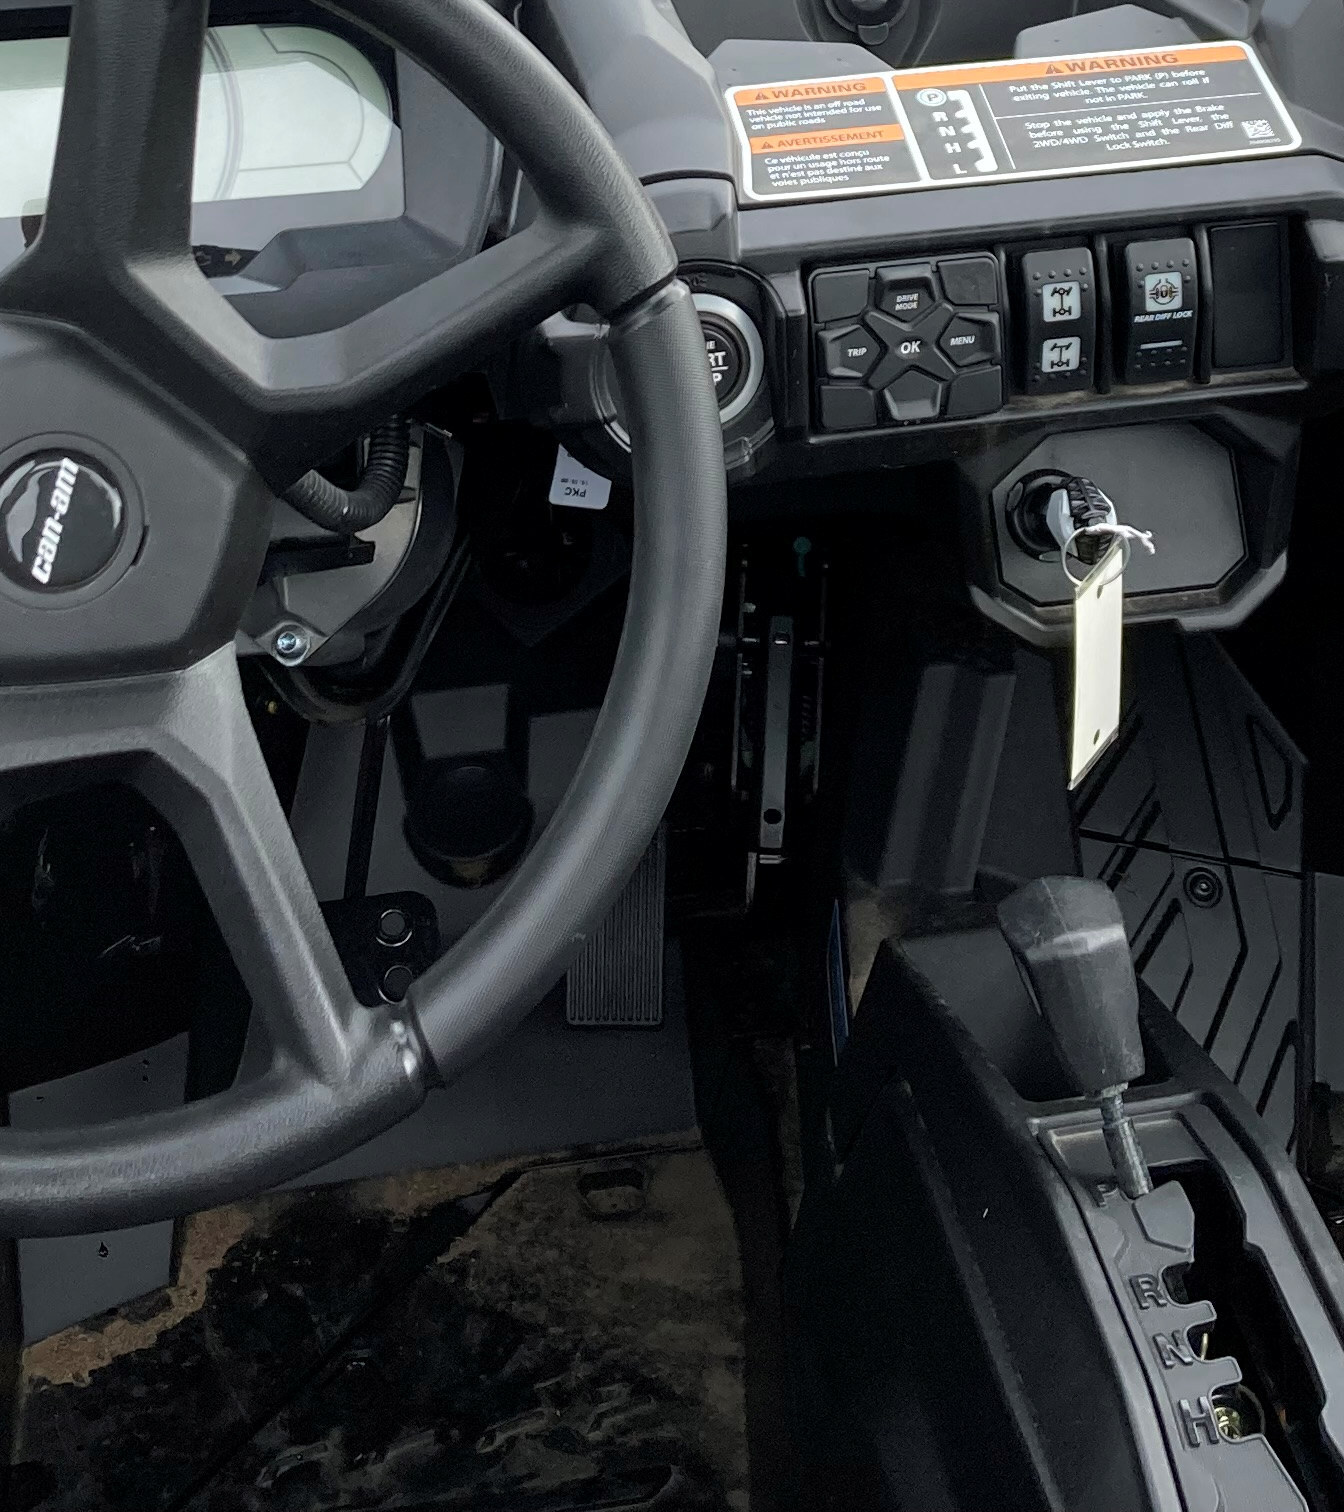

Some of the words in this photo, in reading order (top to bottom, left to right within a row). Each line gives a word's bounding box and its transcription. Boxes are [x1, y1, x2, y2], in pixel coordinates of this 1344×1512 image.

[1065, 54, 1178, 73] WARNING
[771, 83, 867, 99] WARNING
[933, 111, 948, 122] R
[939, 126, 956, 137] N
[777, 130, 885, 148] AVERTISSEMENT
[945, 143, 962, 153] H
[953, 164, 968, 175] L
[896, 293, 919, 303] DRIVE
[895, 301, 918, 311] MODE
[1134, 315, 1155, 323] REAR
[1155, 312, 1172, 321] DIFF
[1173, 310, 1193, 319] LOCK
[950, 335, 975, 346] MENU
[847, 347, 867, 358] TRIP
[900, 340, 921, 354] OK
[564, 486, 587, 498] PKC
[31, 457, 79, 584] can-am
[1129, 1273, 1167, 1310] R
[1153, 1329, 1194, 1370] N
[1179, 1396, 1220, 1448] H
